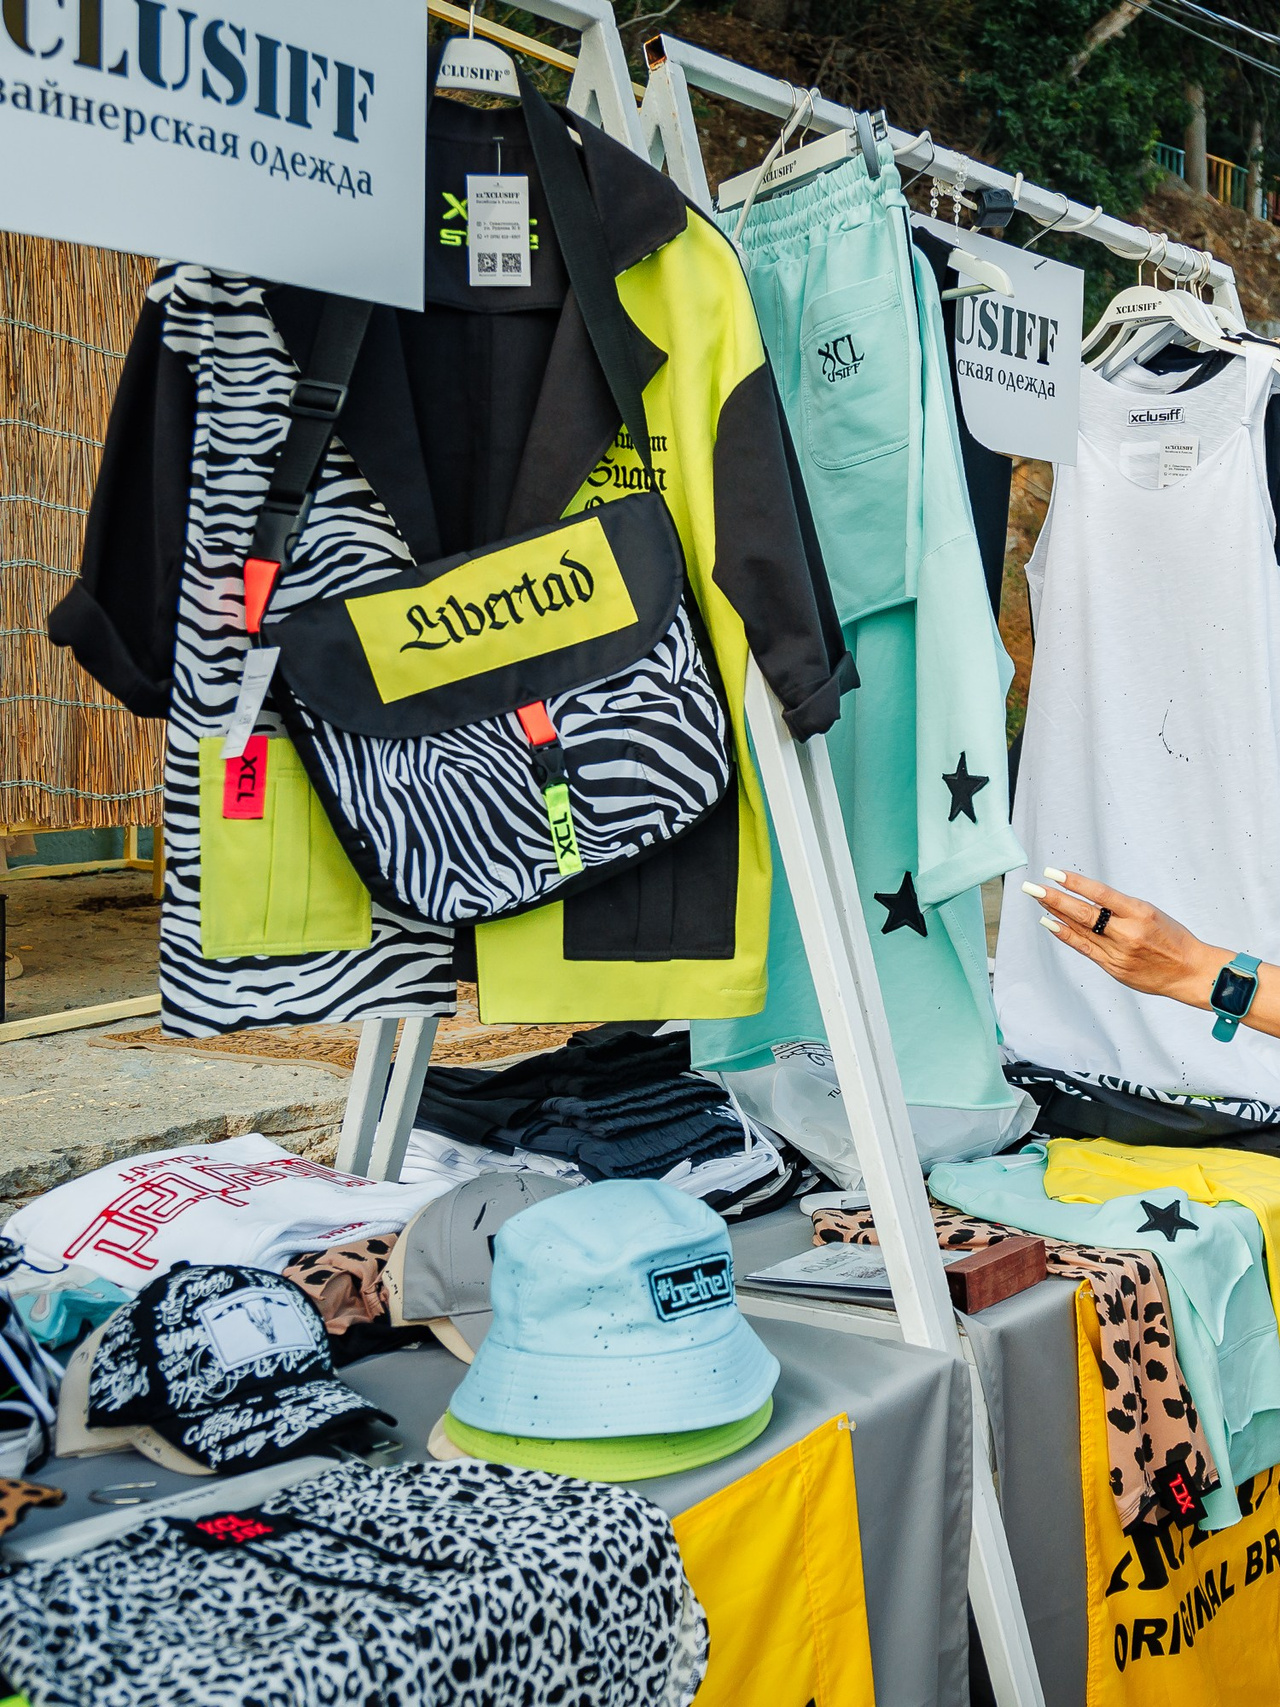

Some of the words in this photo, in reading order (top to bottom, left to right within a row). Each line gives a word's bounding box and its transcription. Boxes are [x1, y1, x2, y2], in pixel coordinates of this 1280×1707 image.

[250, 140, 374, 198] одежда
[997, 369, 1056, 400] одежда
[1130, 408, 1182, 423] xclusiff
[399, 549, 595, 653] Libertad
[237, 755, 258, 802] XCL
[552, 811, 577, 860] XCL
[1168, 1473, 1196, 1514] XCL
[1113, 1560, 1235, 1672] ORIGINAL
